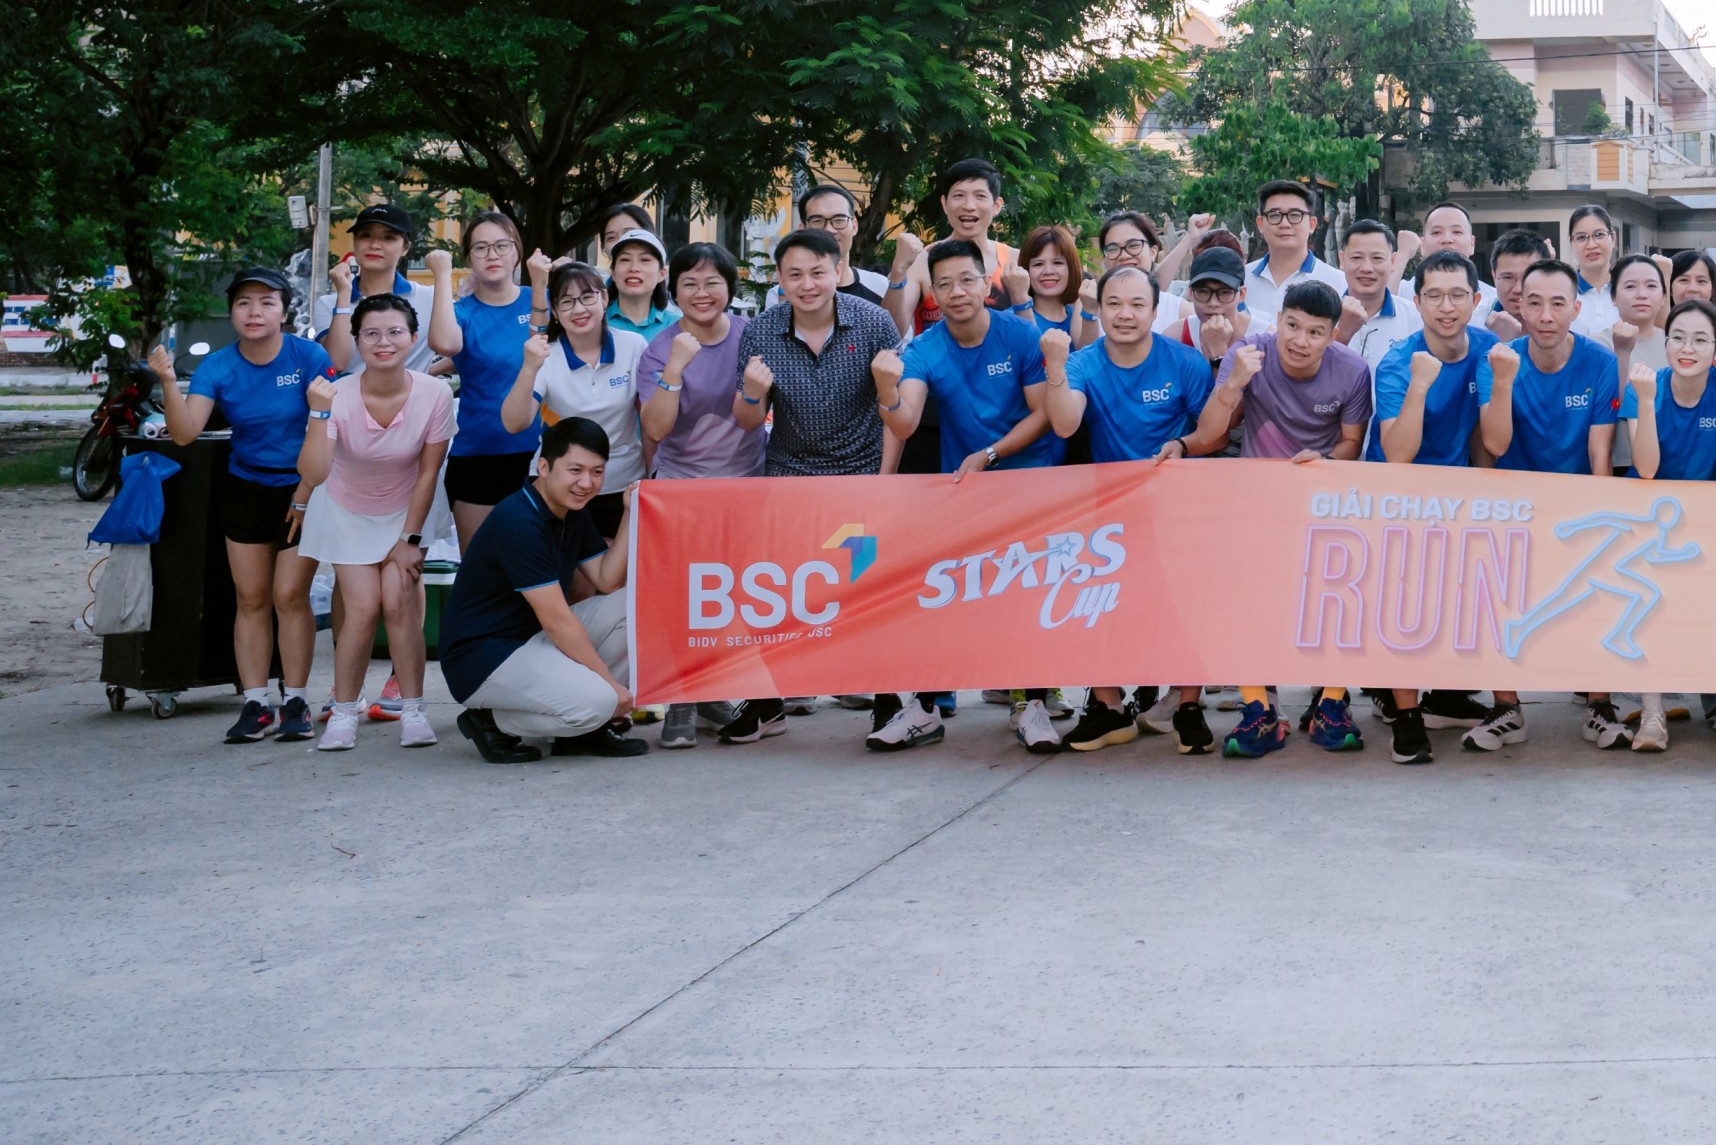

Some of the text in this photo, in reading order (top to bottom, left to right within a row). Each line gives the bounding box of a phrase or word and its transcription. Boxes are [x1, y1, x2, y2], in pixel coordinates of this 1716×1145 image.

[987, 362, 1012, 376] BSC
[277, 373, 300, 387] BSC
[609, 375, 630, 387] BSC
[1142, 389, 1170, 402] BSC
[1565, 394, 1588, 408] BSC
[1314, 403, 1335, 413] BSC
[1310, 488, 1535, 527] GIẢI CHẠY BSC
[917, 523, 1127, 609] STARS
[688, 560, 840, 630] BSC
[1039, 563, 1121, 630] Cup
[1295, 525, 1530, 651] RUN
[688, 636, 718, 648] BIDV
[808, 627, 832, 638] JSC
